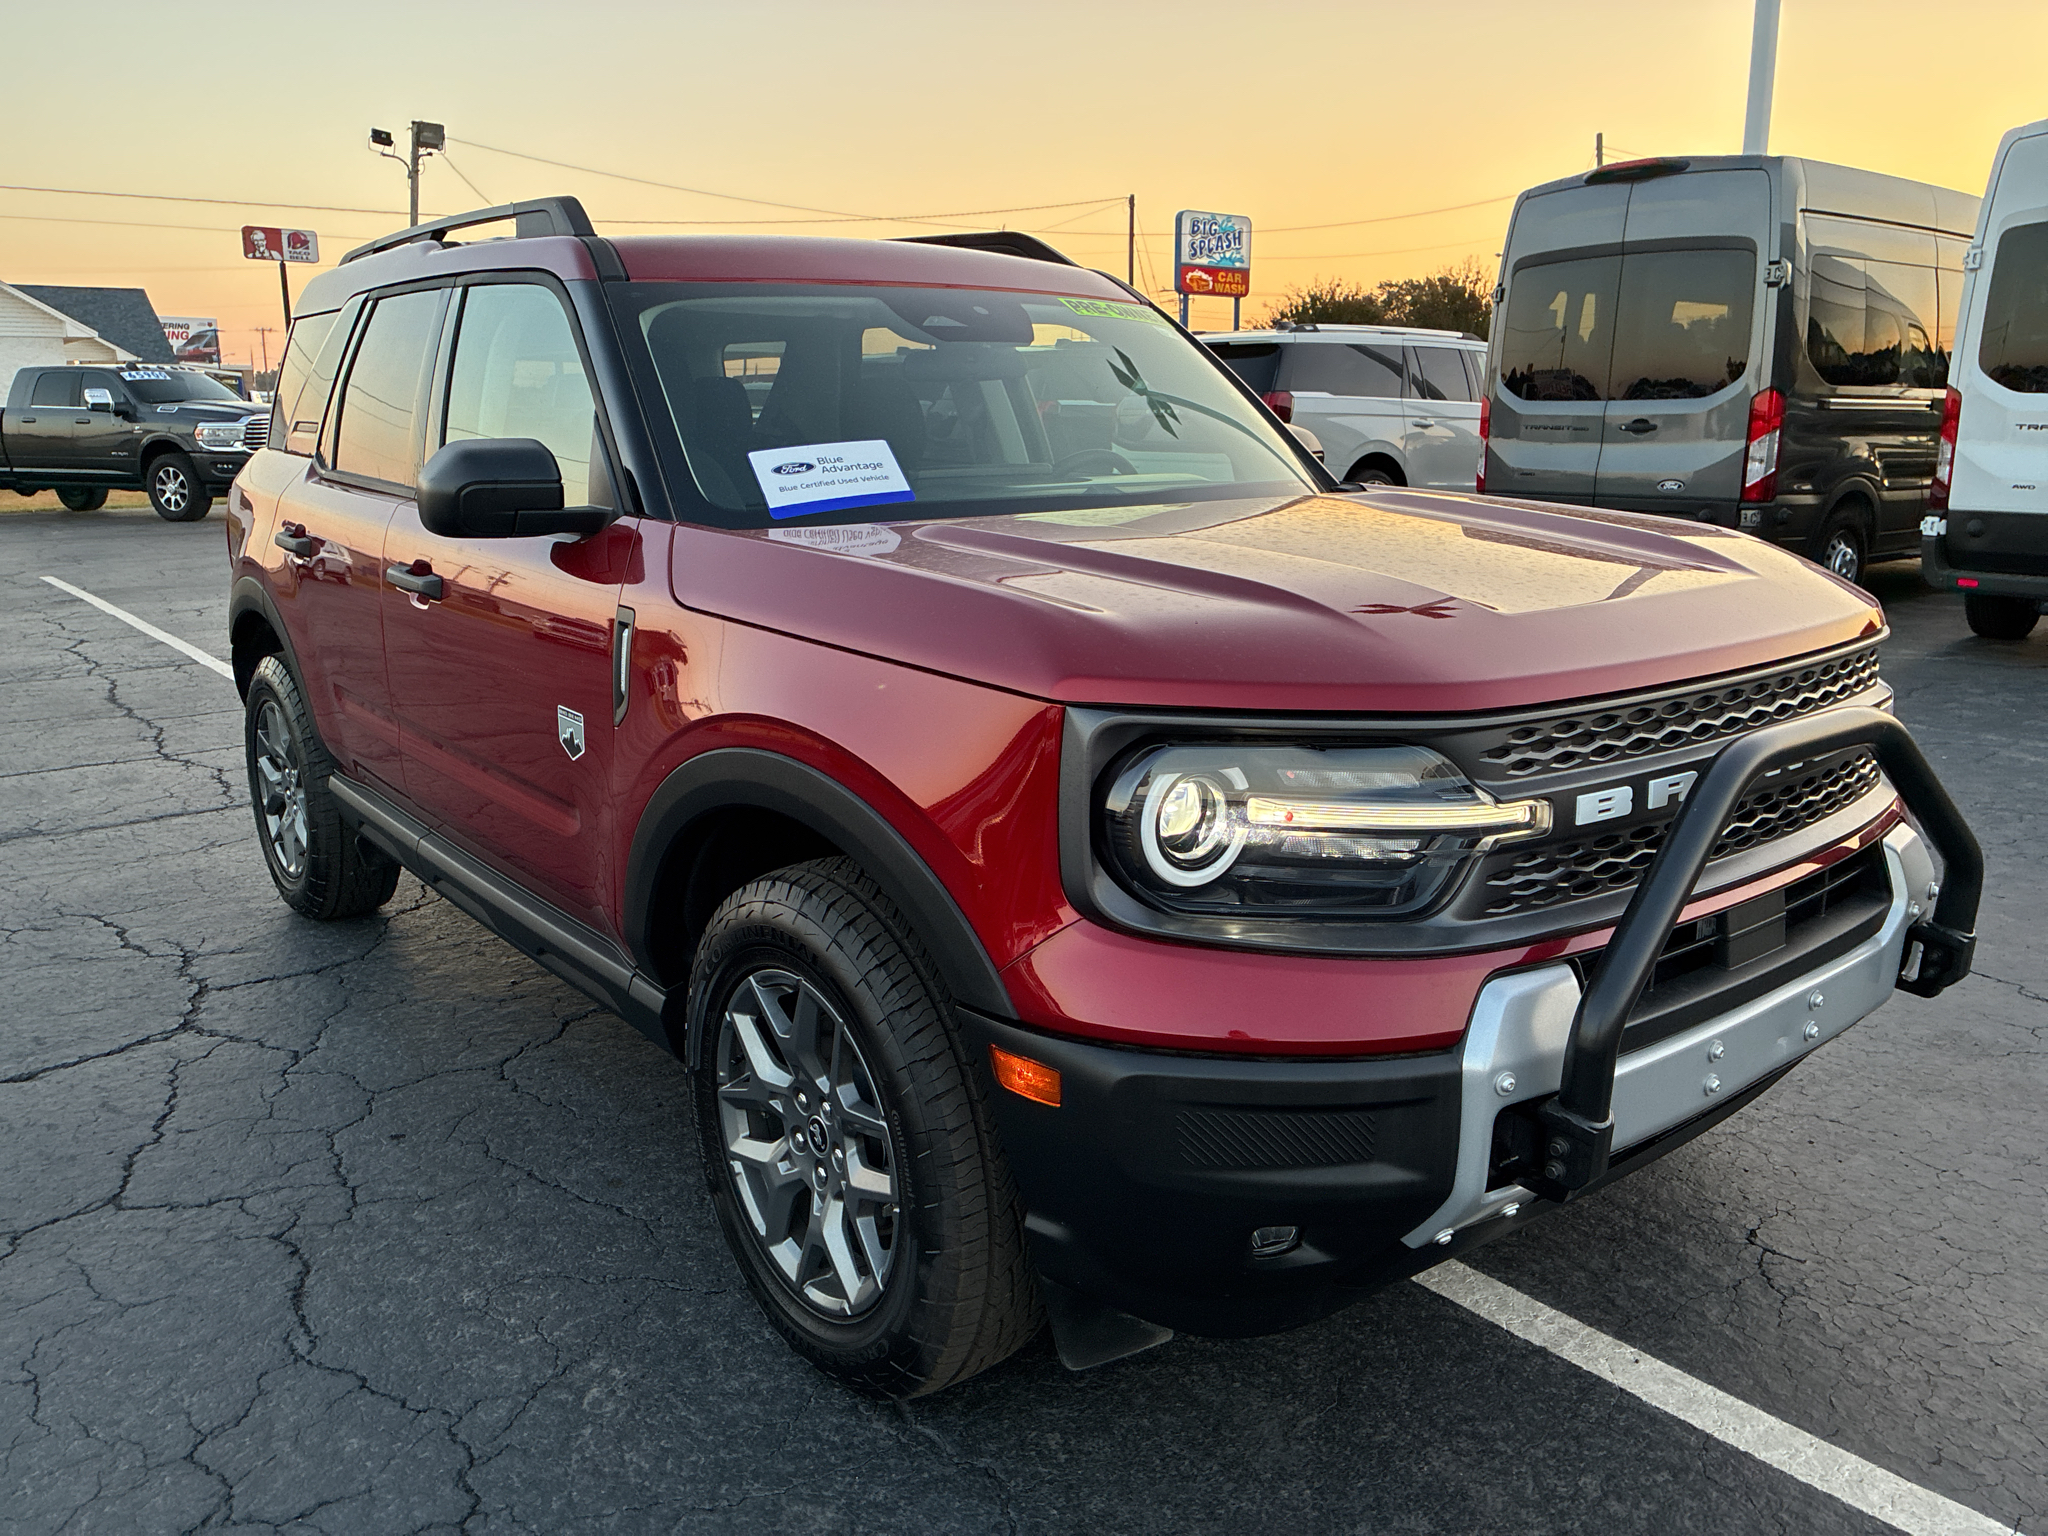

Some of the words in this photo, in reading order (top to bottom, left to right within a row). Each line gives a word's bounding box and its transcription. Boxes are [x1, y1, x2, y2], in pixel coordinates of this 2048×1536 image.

[1191, 219, 1218, 236] BIG
[1190, 229, 1242, 258] SPLASH
[1218, 271, 1242, 284] CAR
[1214, 283, 1246, 295] WASH
[816, 456, 844, 465] Blue
[778, 463, 809, 475] Ford
[822, 461, 883, 474] Advantage
[779, 485, 798, 493] Blue
[800, 480, 836, 489] Certified
